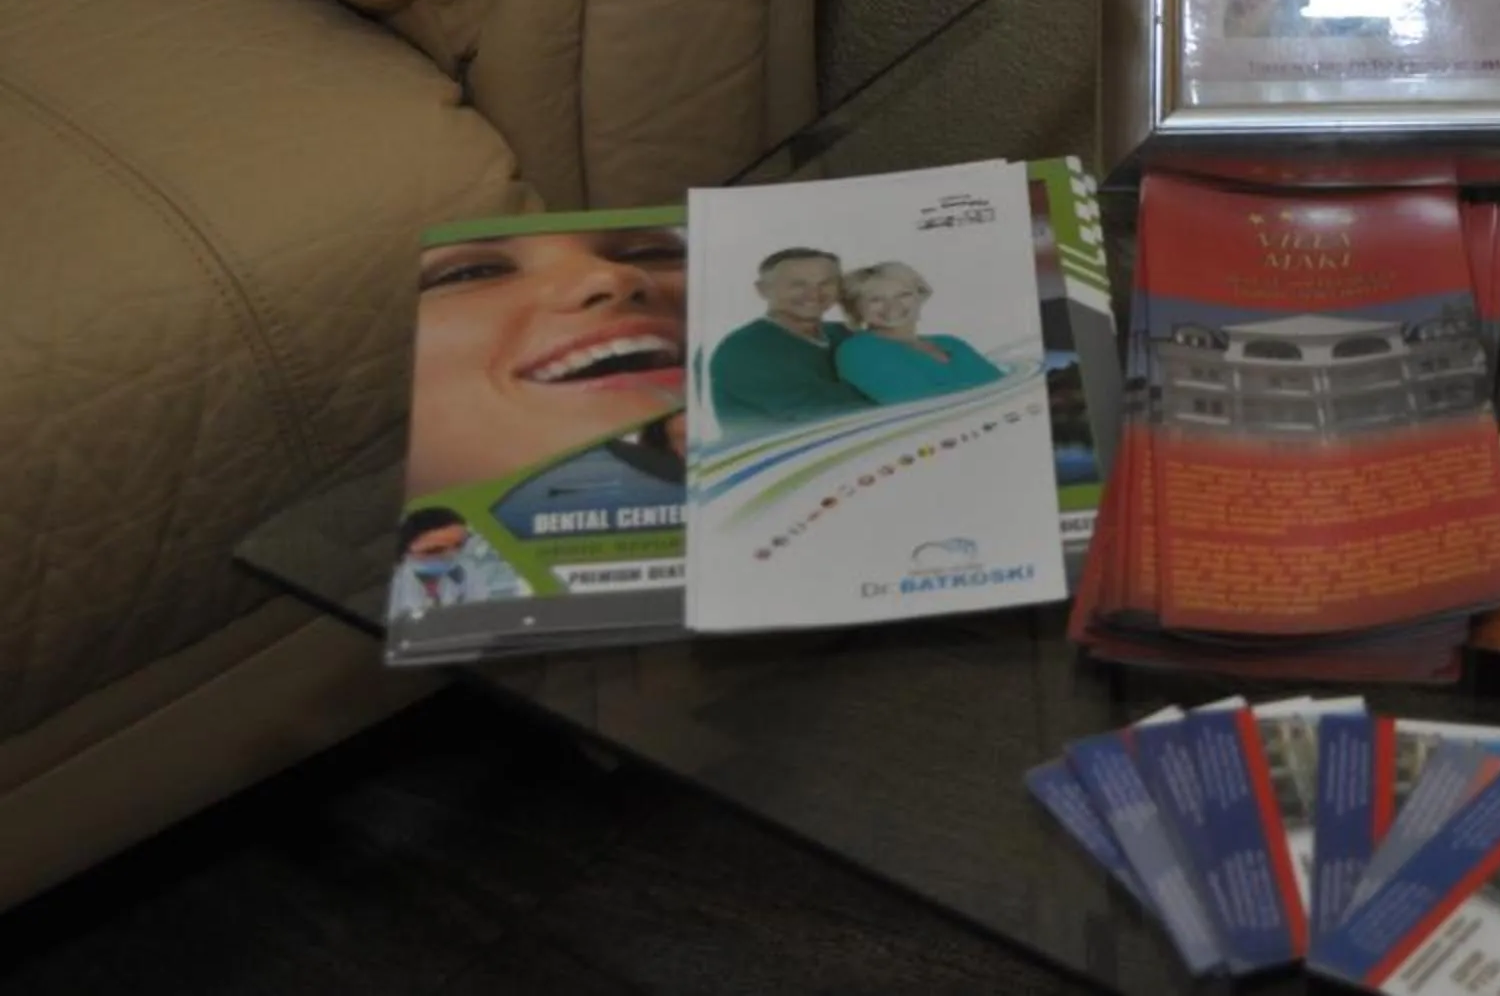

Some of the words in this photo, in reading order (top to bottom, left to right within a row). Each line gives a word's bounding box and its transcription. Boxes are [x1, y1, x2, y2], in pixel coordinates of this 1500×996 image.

[533, 508, 610, 535] DENTAL
[617, 505, 687, 529] CENTE
[569, 567, 642, 585] PREMIUM
[900, 563, 1036, 595] BATKOSKI
